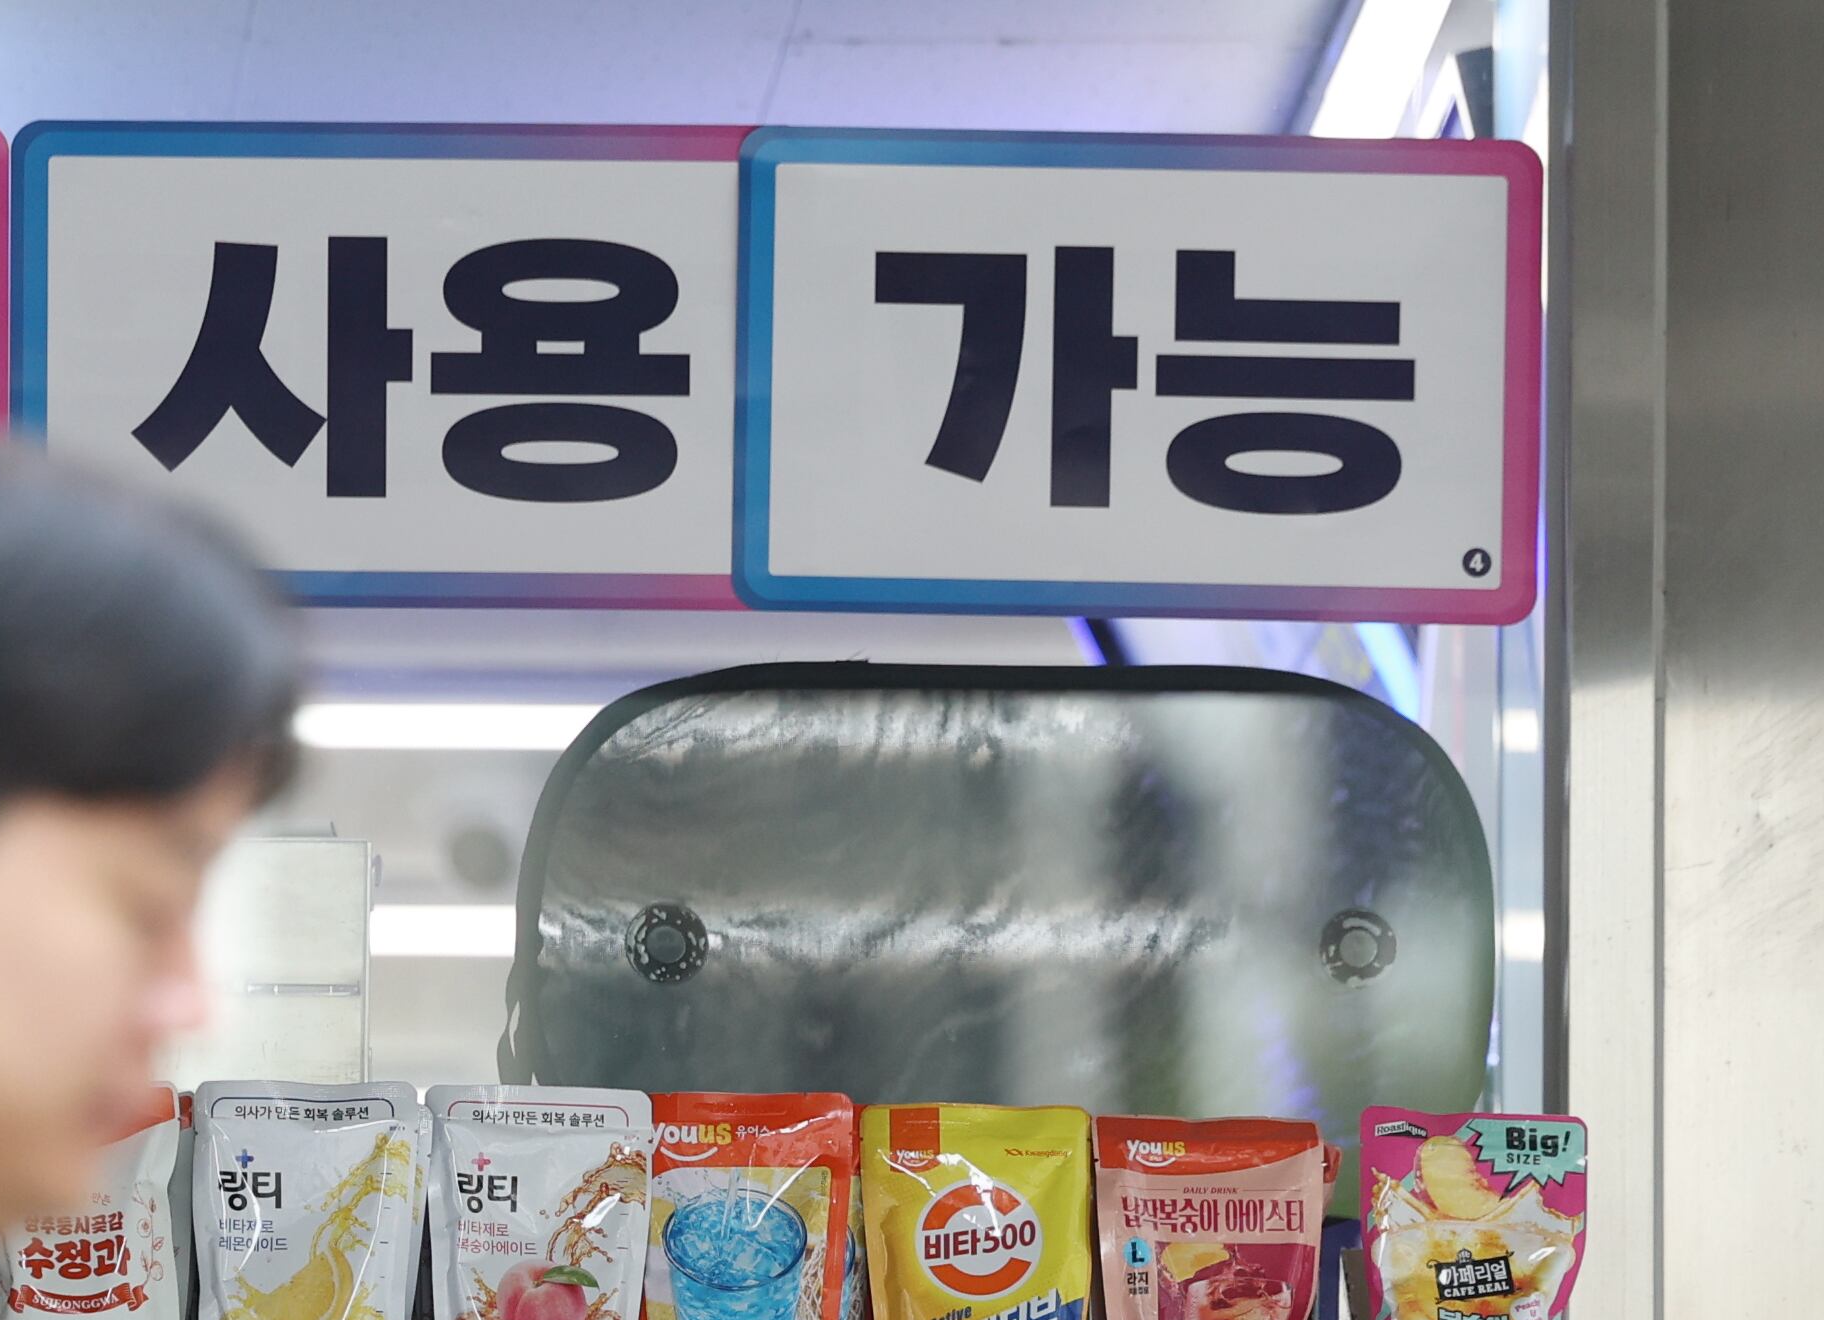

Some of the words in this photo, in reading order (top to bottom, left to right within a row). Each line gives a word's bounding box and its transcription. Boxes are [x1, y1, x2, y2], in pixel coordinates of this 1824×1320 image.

[132, 236, 690, 503] 사용
[875, 246, 1416, 515] 가능
[472, 1109, 509, 1125] 의사가
[512, 1109, 538, 1125] 만든
[541, 1110, 566, 1126] 회복
[569, 1111, 605, 1128] 솔루션
[1126, 1139, 1186, 1161] youus
[1504, 1125, 1573, 1156] Big!
[1505, 1153, 1543, 1166] SIZE
[217, 1170, 282, 1210] 링티
[1226, 1199, 1305, 1233] 아이스티
[457, 1237, 537, 1257] 복숭아에이드
[924, 1220, 1036, 1260] 비타500
[21, 1235, 131, 1280] 수정과
[1444, 1286, 1476, 1298] CAFE
[1478, 1281, 1510, 1295] REAL
